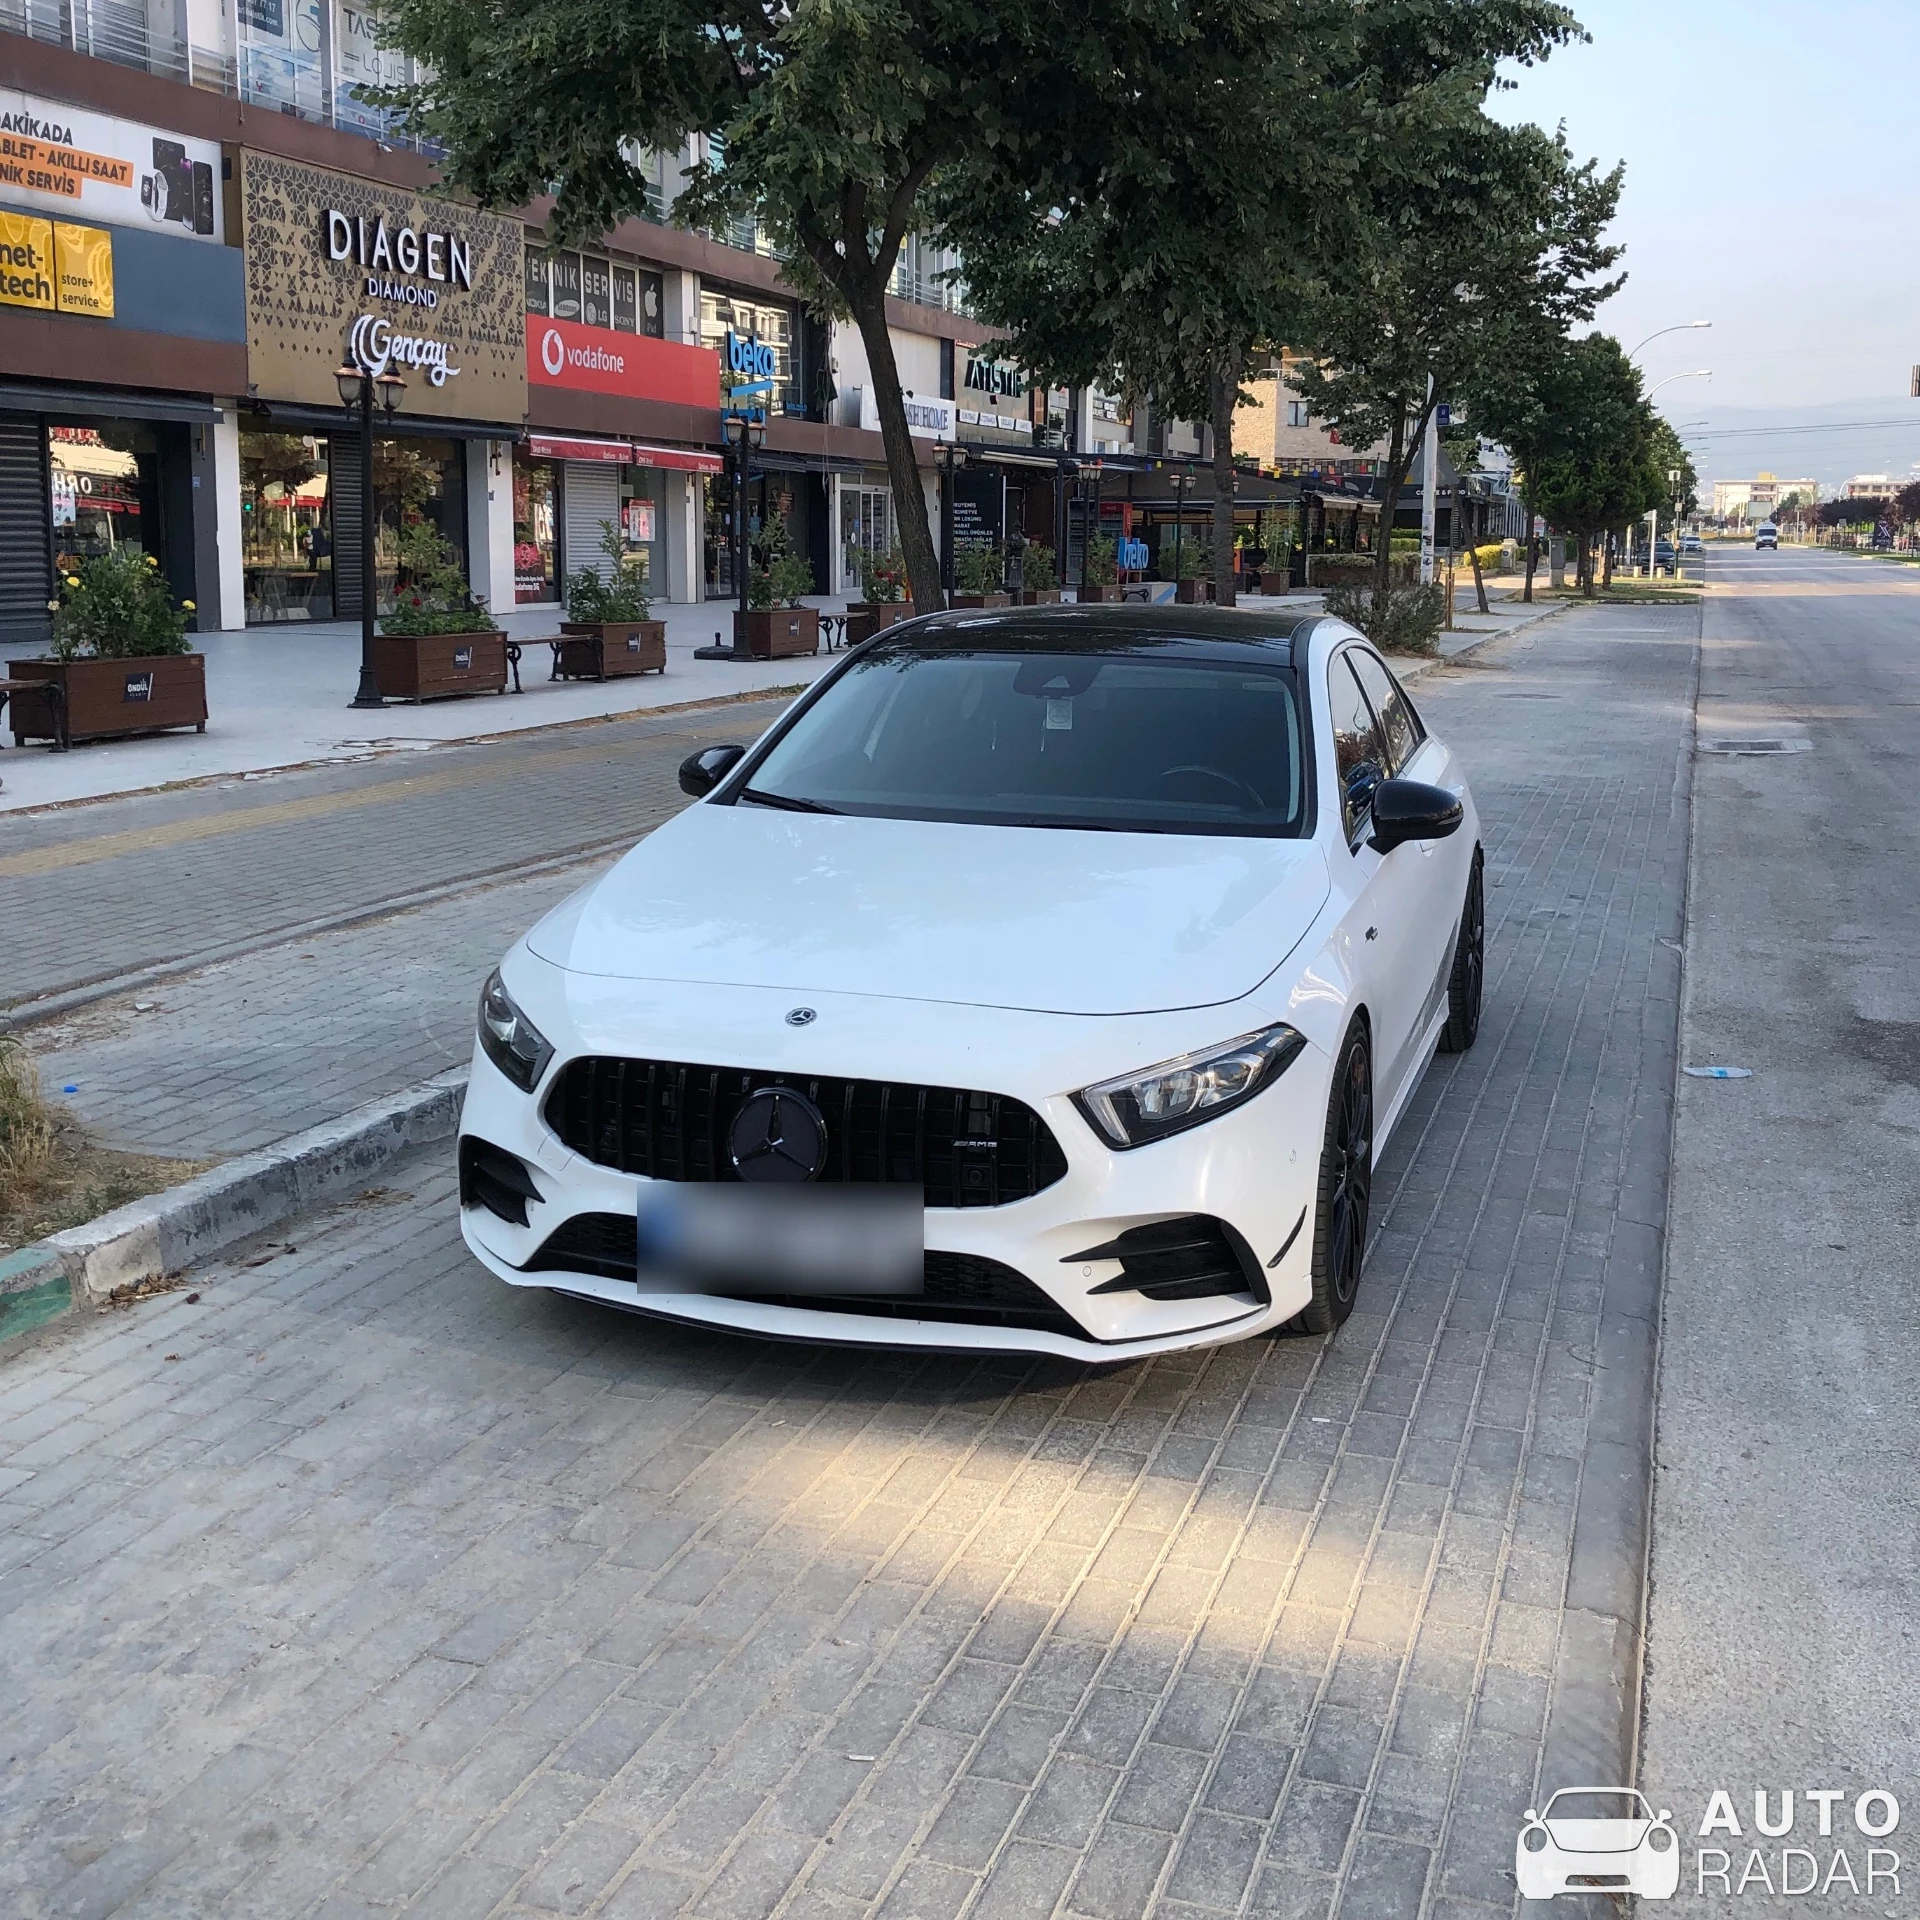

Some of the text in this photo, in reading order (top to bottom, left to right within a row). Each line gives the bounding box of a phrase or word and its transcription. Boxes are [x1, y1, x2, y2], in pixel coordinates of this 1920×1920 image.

[0, 111, 73, 146] AKİKADA
[46, 150, 90, 173] AKILLI
[91, 160, 128, 181] SAAT
[27, 170, 75, 195] SERVİS
[328, 208, 471, 291] DIAGEN
[0, 269, 50, 302] tech
[61, 273, 94, 288] store+
[367, 276, 438, 309] DIAMOND
[62, 293, 99, 308] service
[597, 309, 608, 322] LG
[614, 315, 635, 328] SONY
[567, 347, 625, 374] vodafone
[729, 331, 775, 377] beko
[1123, 537, 1149, 570] beko
